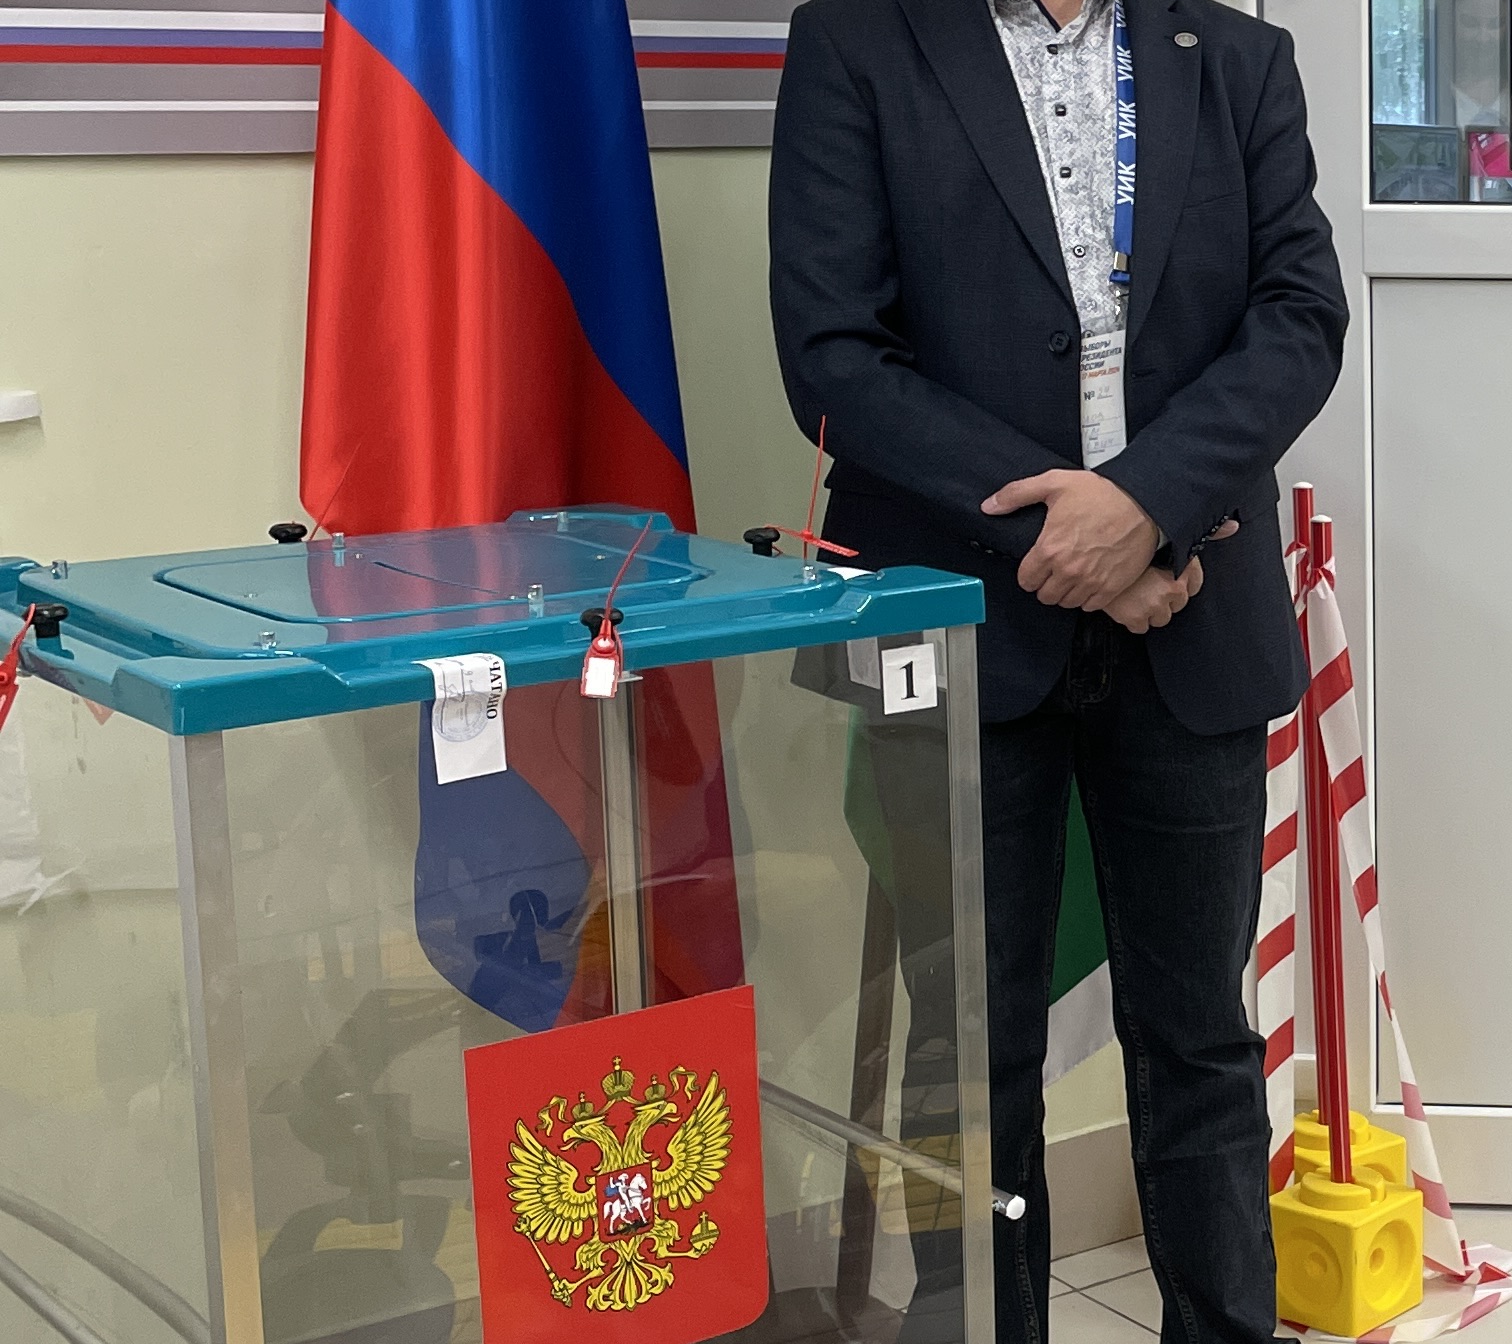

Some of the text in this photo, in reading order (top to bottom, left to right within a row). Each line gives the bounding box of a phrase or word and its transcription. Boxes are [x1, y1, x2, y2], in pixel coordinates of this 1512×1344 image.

[1116, 44, 1134, 82] УИК
[1118, 101, 1137, 140] УИК
[1116, 160, 1137, 206] УИК
[899, 660, 919, 701] 1
